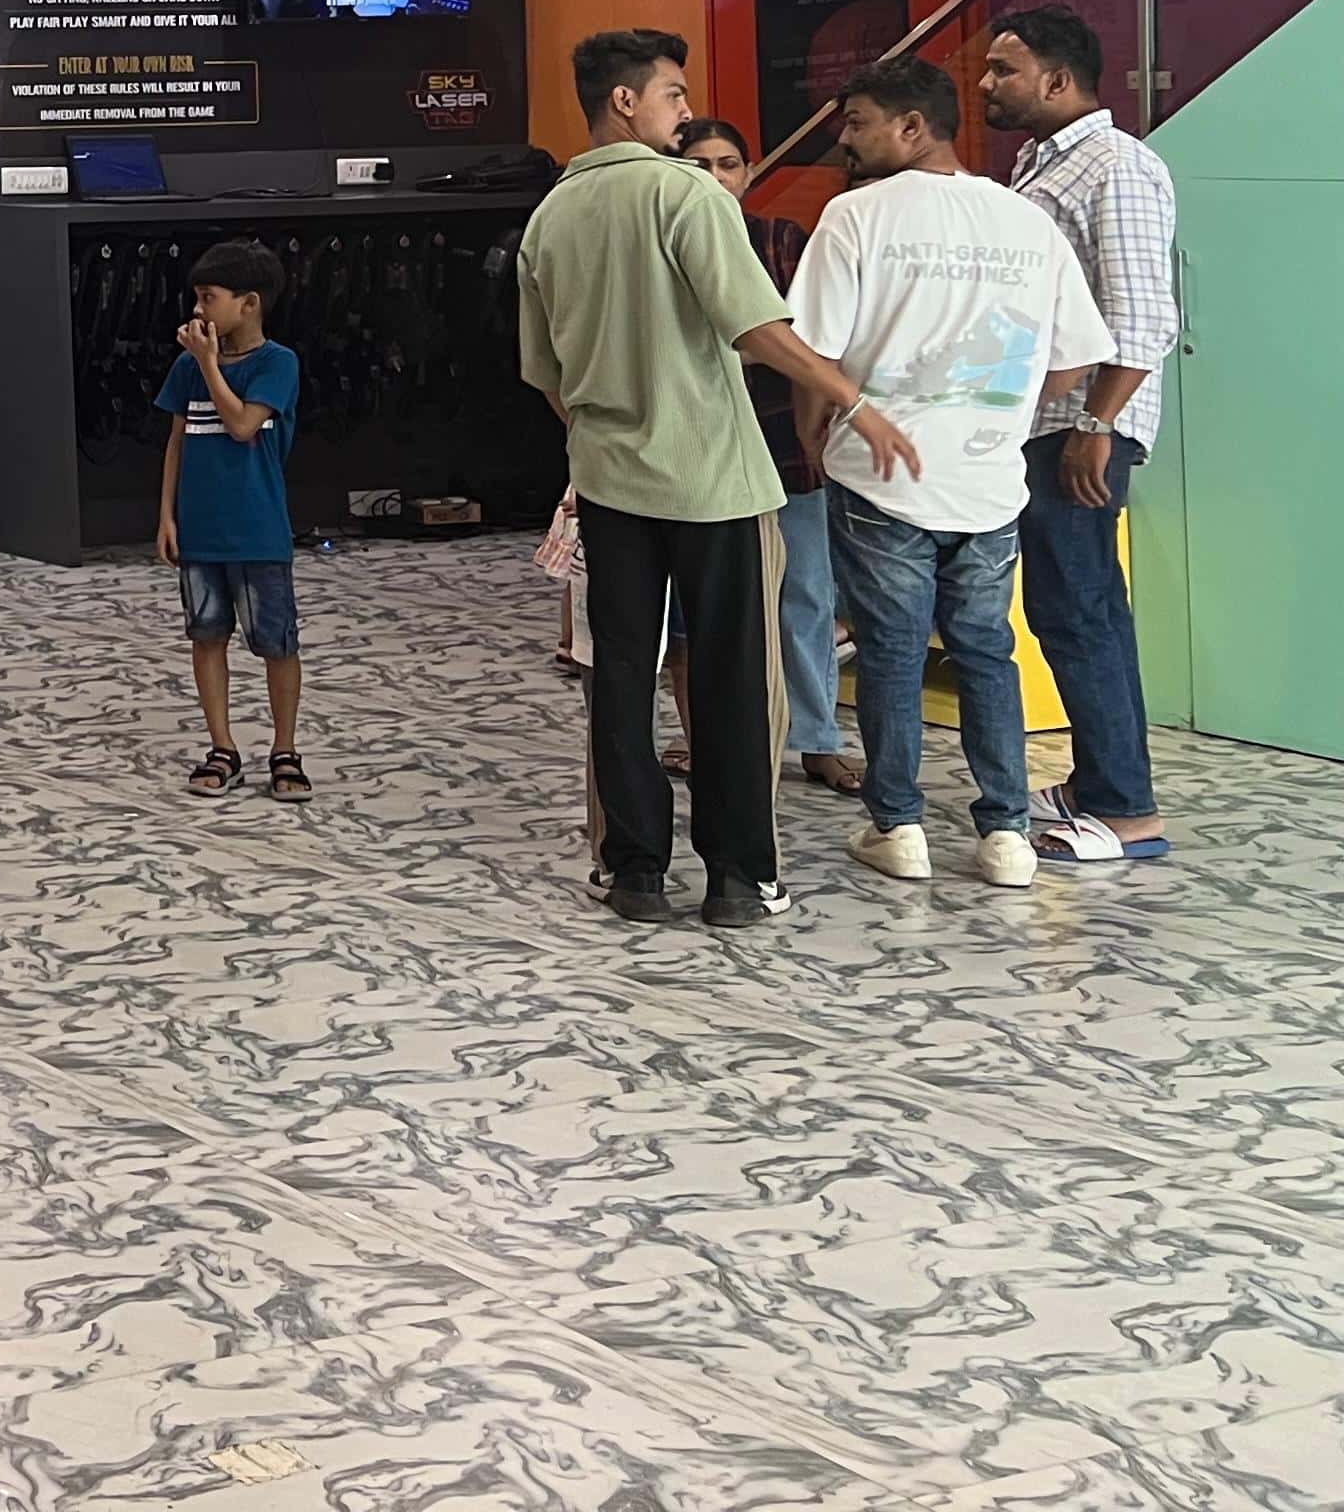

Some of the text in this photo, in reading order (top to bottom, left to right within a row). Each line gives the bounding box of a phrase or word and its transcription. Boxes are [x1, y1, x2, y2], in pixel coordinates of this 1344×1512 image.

[10, 14, 239, 29] PLAY FAIR PLAY SMART AND GIVE IT YOUR ALL
[59, 55, 195, 74] ENTER AT YOUR OWN RISK
[12, 80, 241, 97] VIOLATION OF THESE RULES WILL RESULT IN YOUR
[428, 75, 474, 89] SKY
[415, 93, 488, 108] LASER
[40, 106, 215, 121] IMMEDIATE REMOVAL FROM THE GAME
